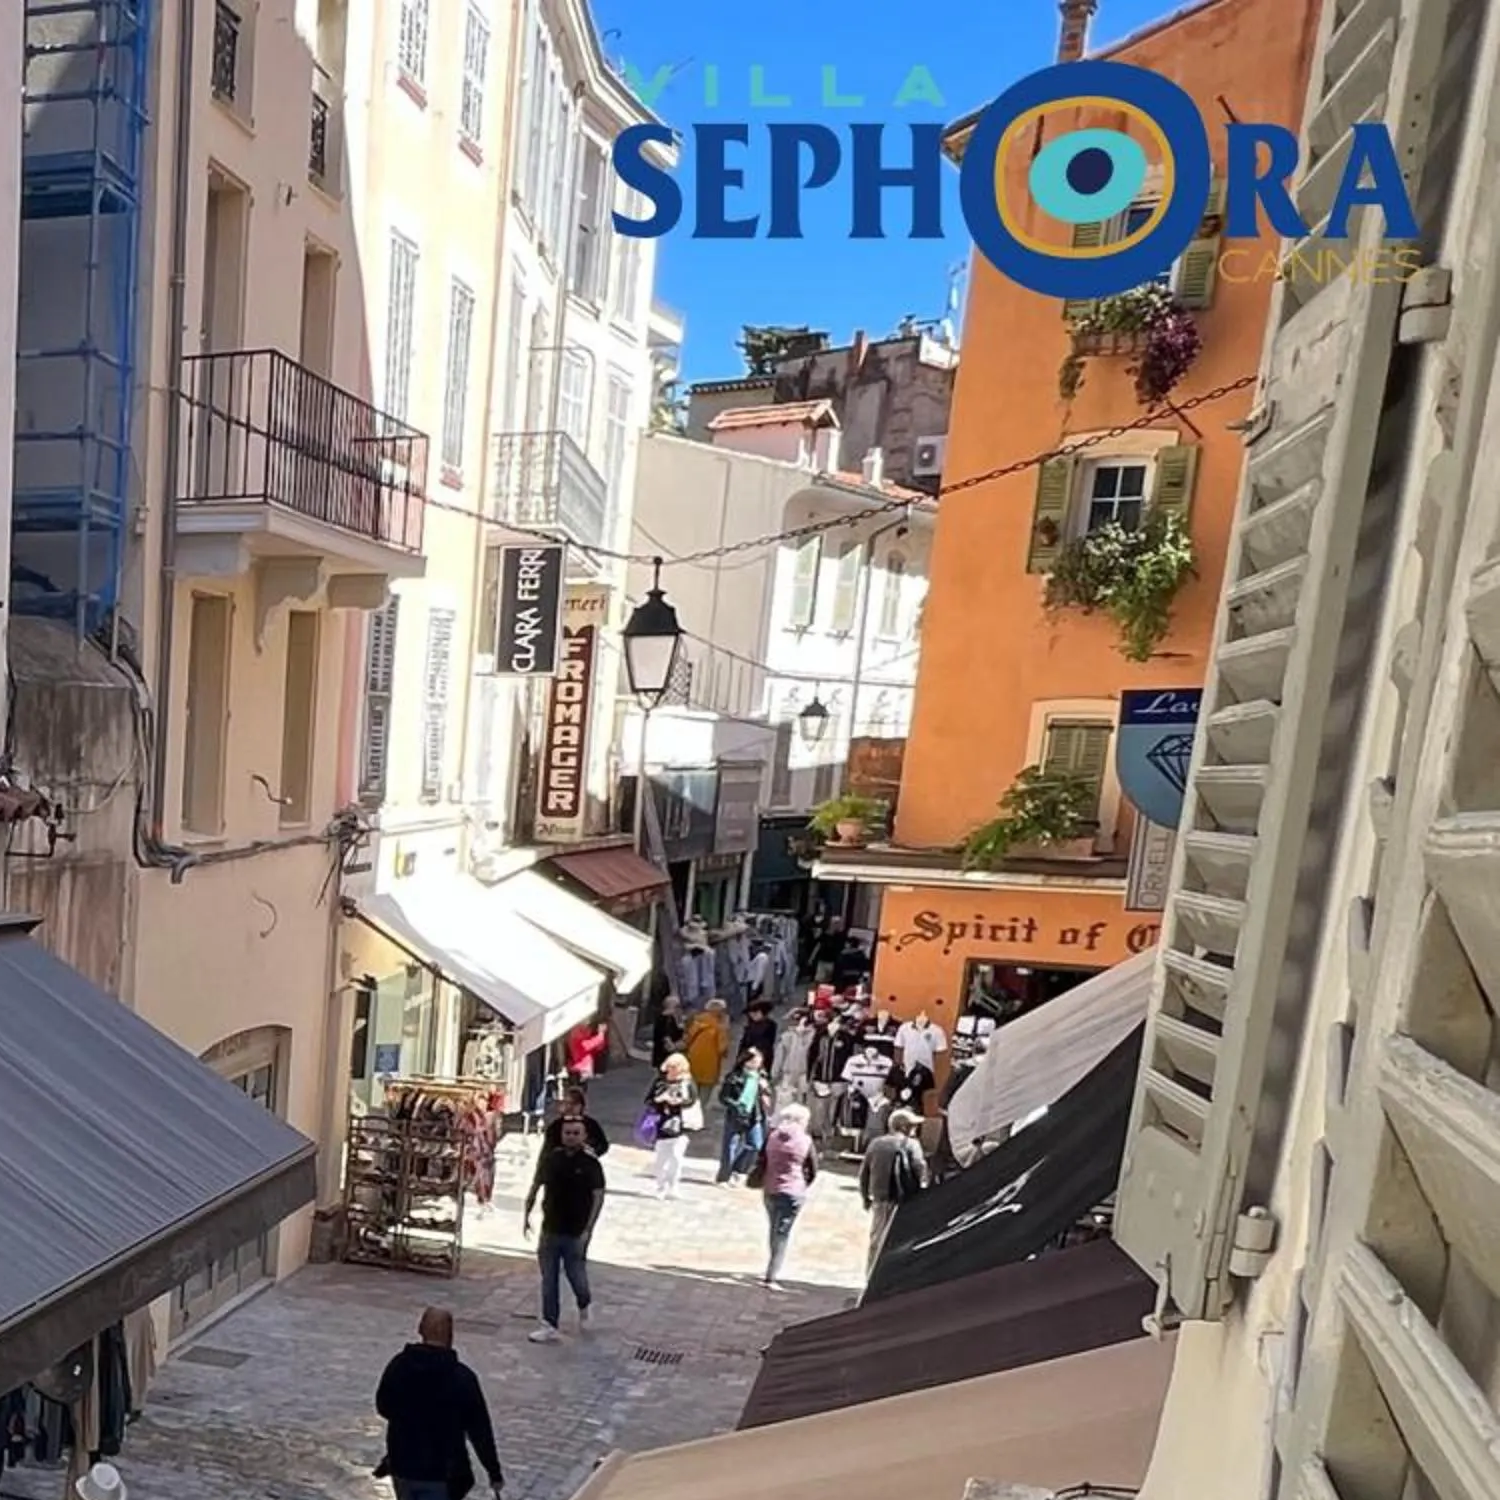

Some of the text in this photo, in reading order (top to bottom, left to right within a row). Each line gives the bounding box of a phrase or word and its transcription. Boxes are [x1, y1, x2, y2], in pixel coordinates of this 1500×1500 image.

[511, 607, 543, 673] CLARA
[547, 637, 588, 811] FROMAGER
[895, 911, 1039, 955] Spirit
[1057, 922, 1108, 951] of
